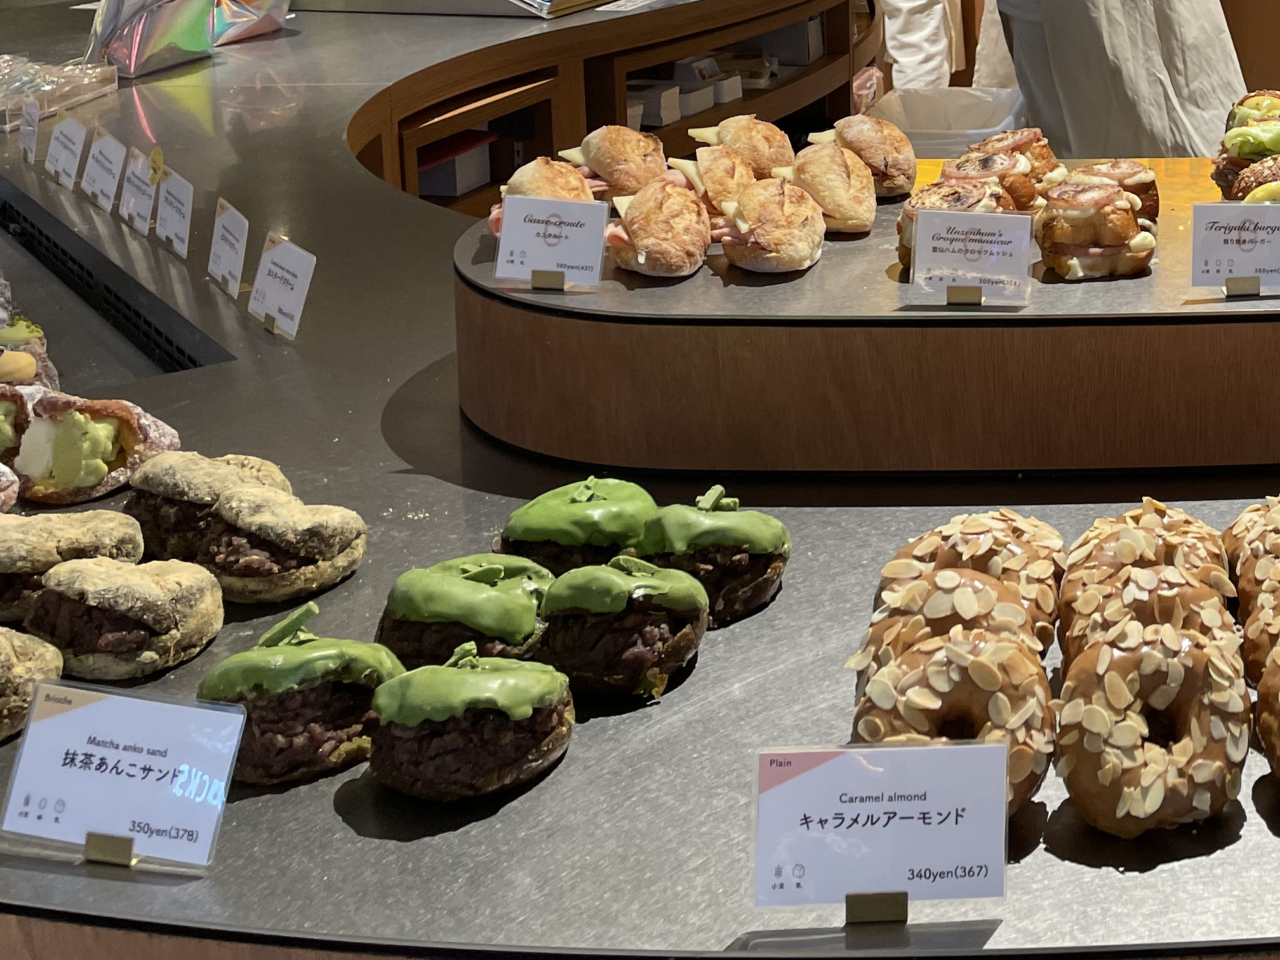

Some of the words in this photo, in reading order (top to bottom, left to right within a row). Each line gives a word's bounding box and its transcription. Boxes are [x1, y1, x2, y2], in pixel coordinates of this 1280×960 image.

[1205, 221, 1251, 235] Teriyaki
[86, 735, 119, 750] Matcha
[122, 742, 144, 754] anko
[146, 747, 168, 758] sand
[61, 748, 183, 785] 抹茶あんこサンド
[769, 758, 792, 768] Plain
[839, 792, 884, 804] Caramel
[887, 791, 927, 803] almond
[799, 807, 966, 831] キャラメルアーモンド
[128, 820, 199, 843] 350yen(378)
[907, 864, 989, 882] 340yen(367)
